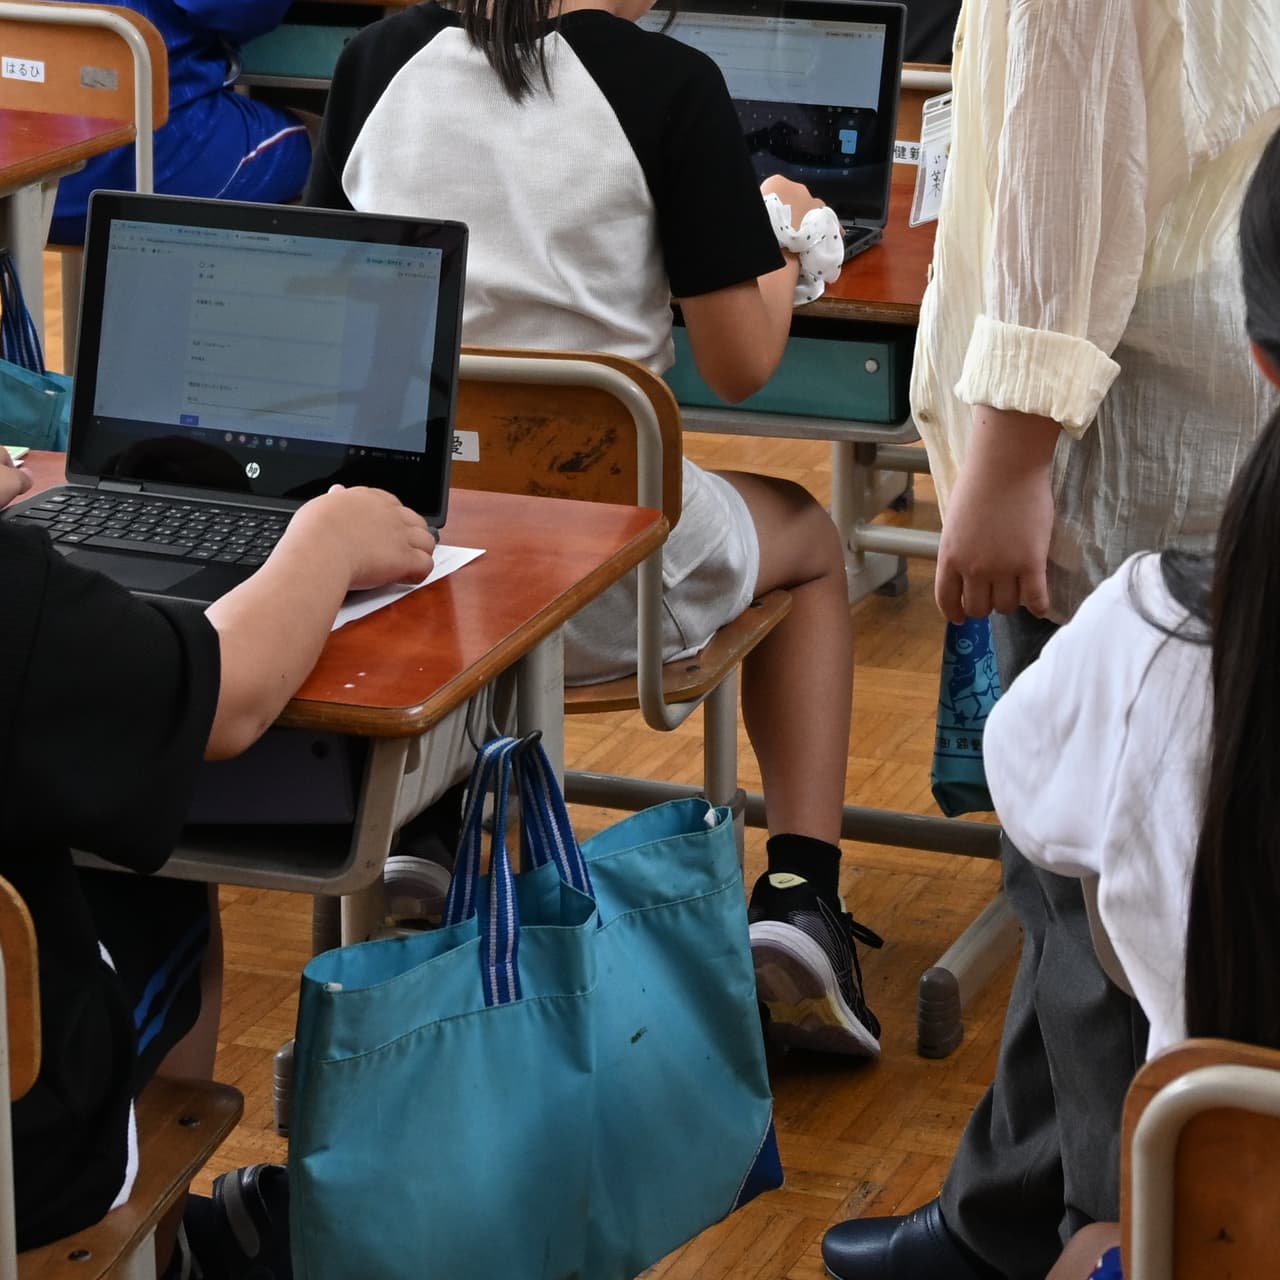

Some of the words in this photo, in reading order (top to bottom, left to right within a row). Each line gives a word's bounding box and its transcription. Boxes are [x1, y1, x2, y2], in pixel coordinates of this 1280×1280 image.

[6, 62, 40, 78] はるひ
[246, 462, 260, 478] hp
